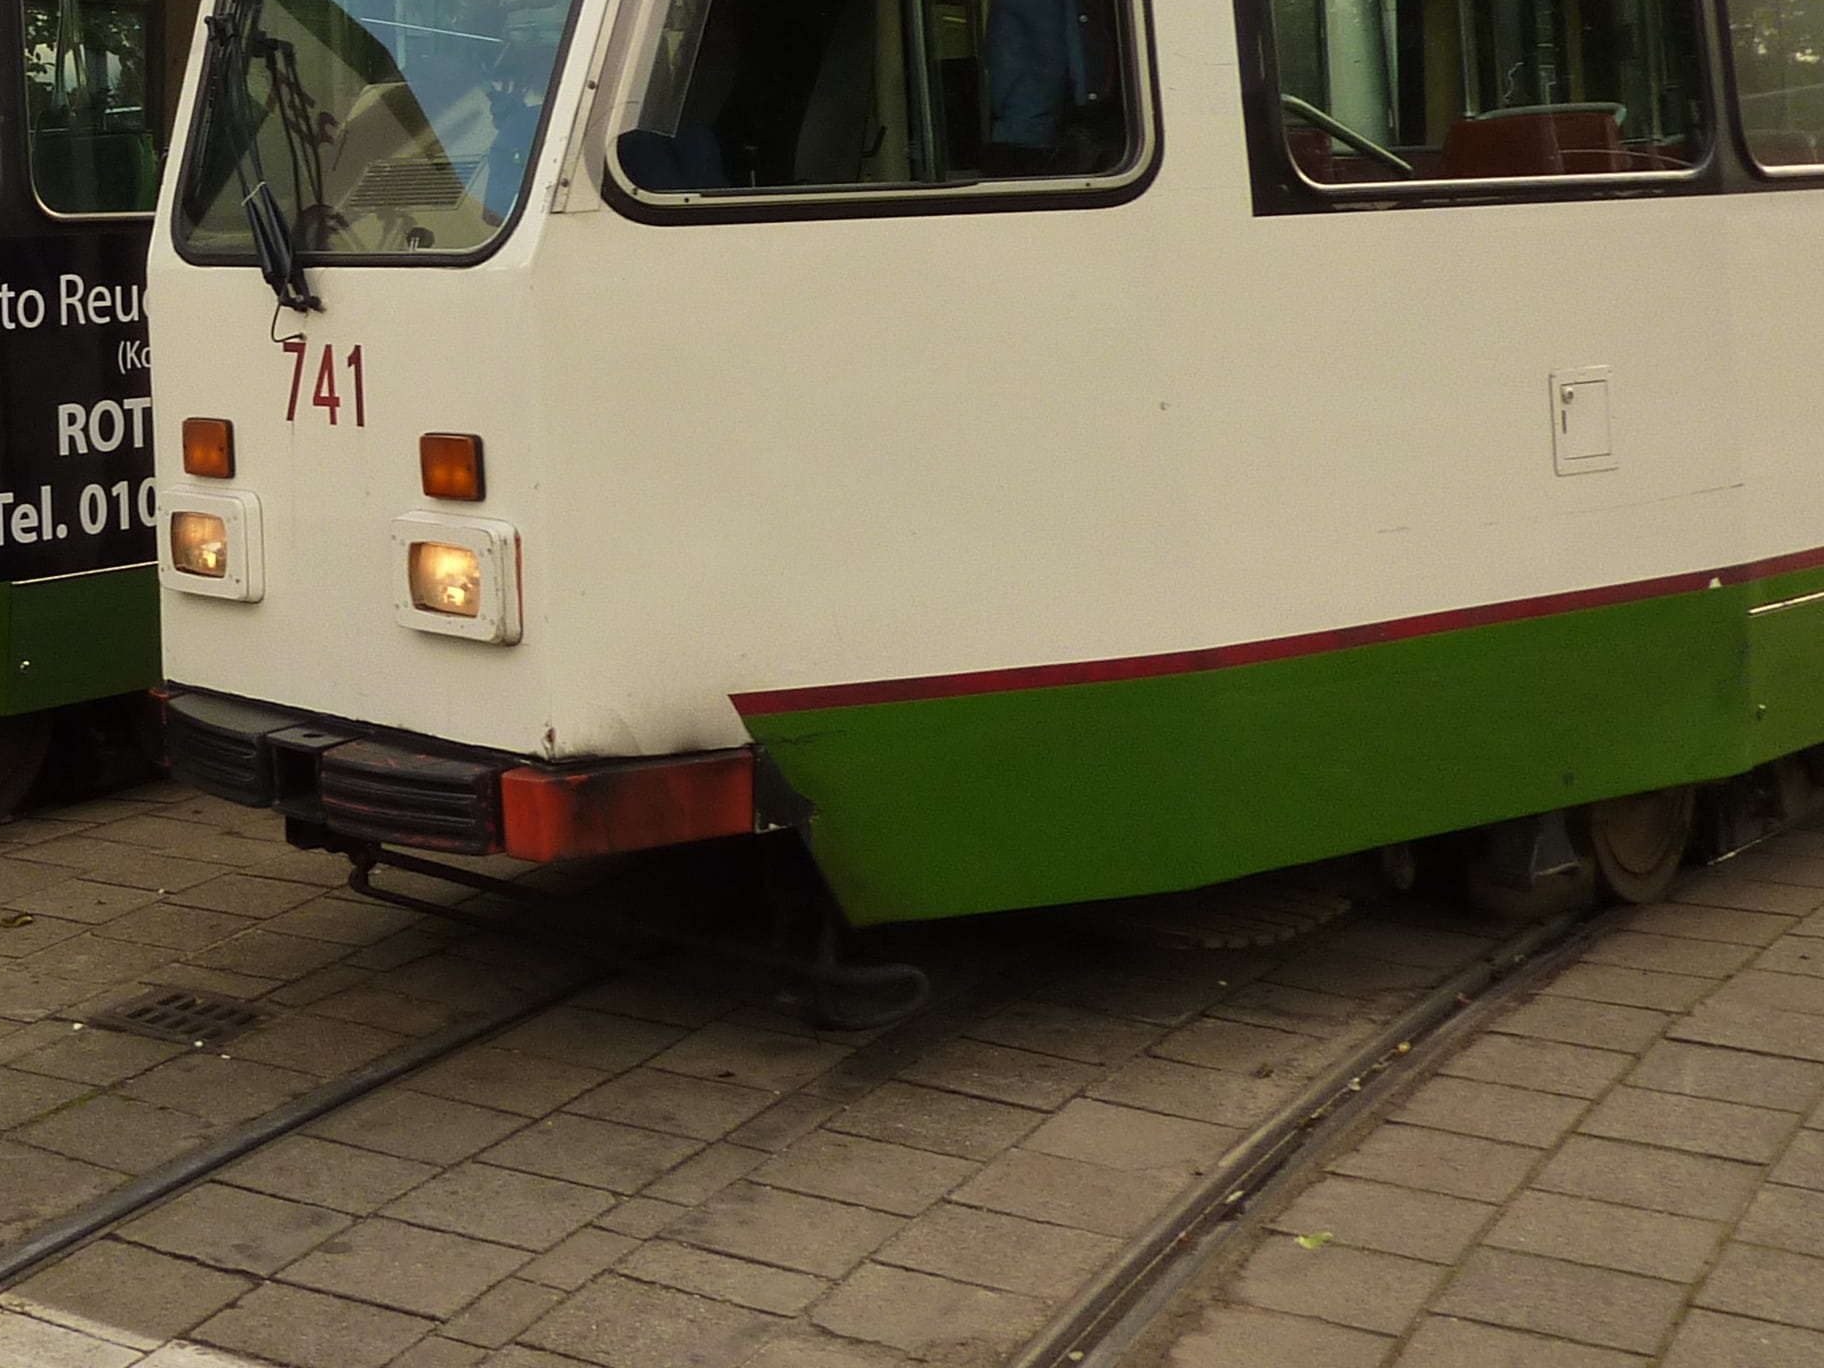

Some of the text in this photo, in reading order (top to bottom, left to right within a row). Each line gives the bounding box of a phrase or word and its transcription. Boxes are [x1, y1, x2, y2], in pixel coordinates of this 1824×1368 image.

[283, 341, 365, 427] 741
[58, 397, 152, 456] ROT
[79, 477, 158, 535] 010
